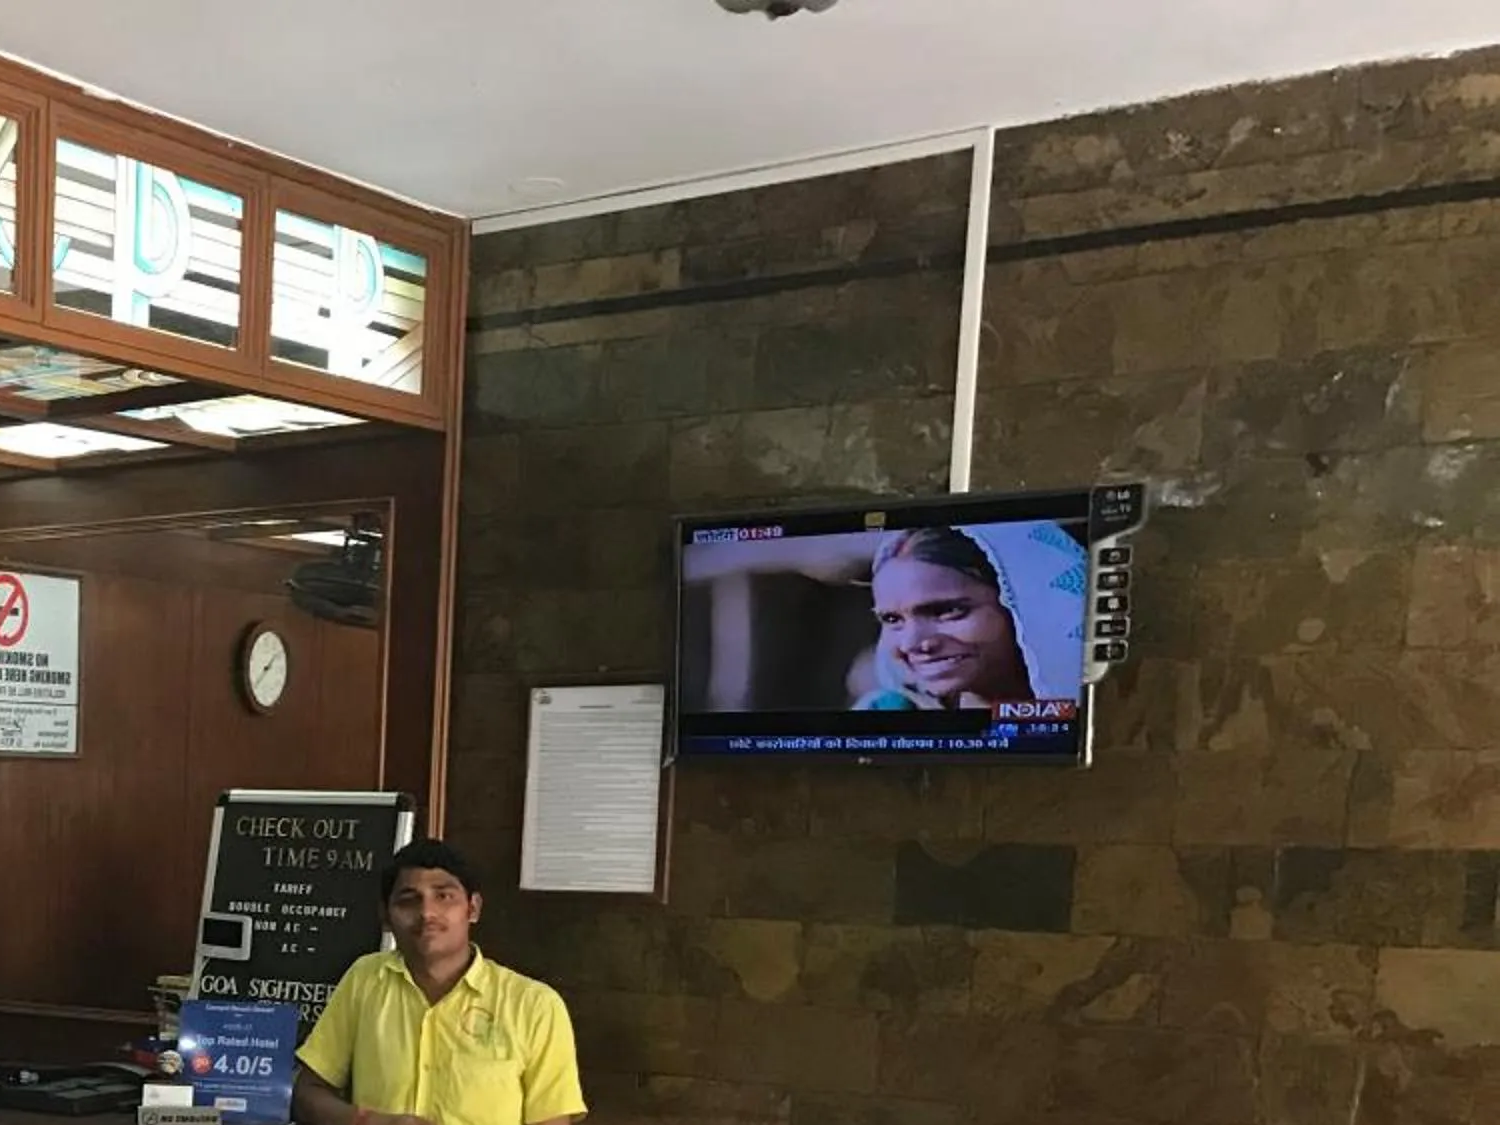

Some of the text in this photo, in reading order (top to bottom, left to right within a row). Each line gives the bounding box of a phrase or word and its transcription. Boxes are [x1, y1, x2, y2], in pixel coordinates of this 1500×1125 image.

[999, 702, 1060, 718] INDIA
[236, 815, 361, 840] CHECK OUT
[262, 846, 321, 869] TIME
[228, 901, 347, 918] DOUBLE OCCUPANCY
[254, 920, 300, 932] NON AC
[201, 975, 238, 995] GOA
[217, 1035, 249, 1047] Rated
[251, 1037, 279, 1049] Hotel
[213, 1053, 274, 1076] 4.0/5
